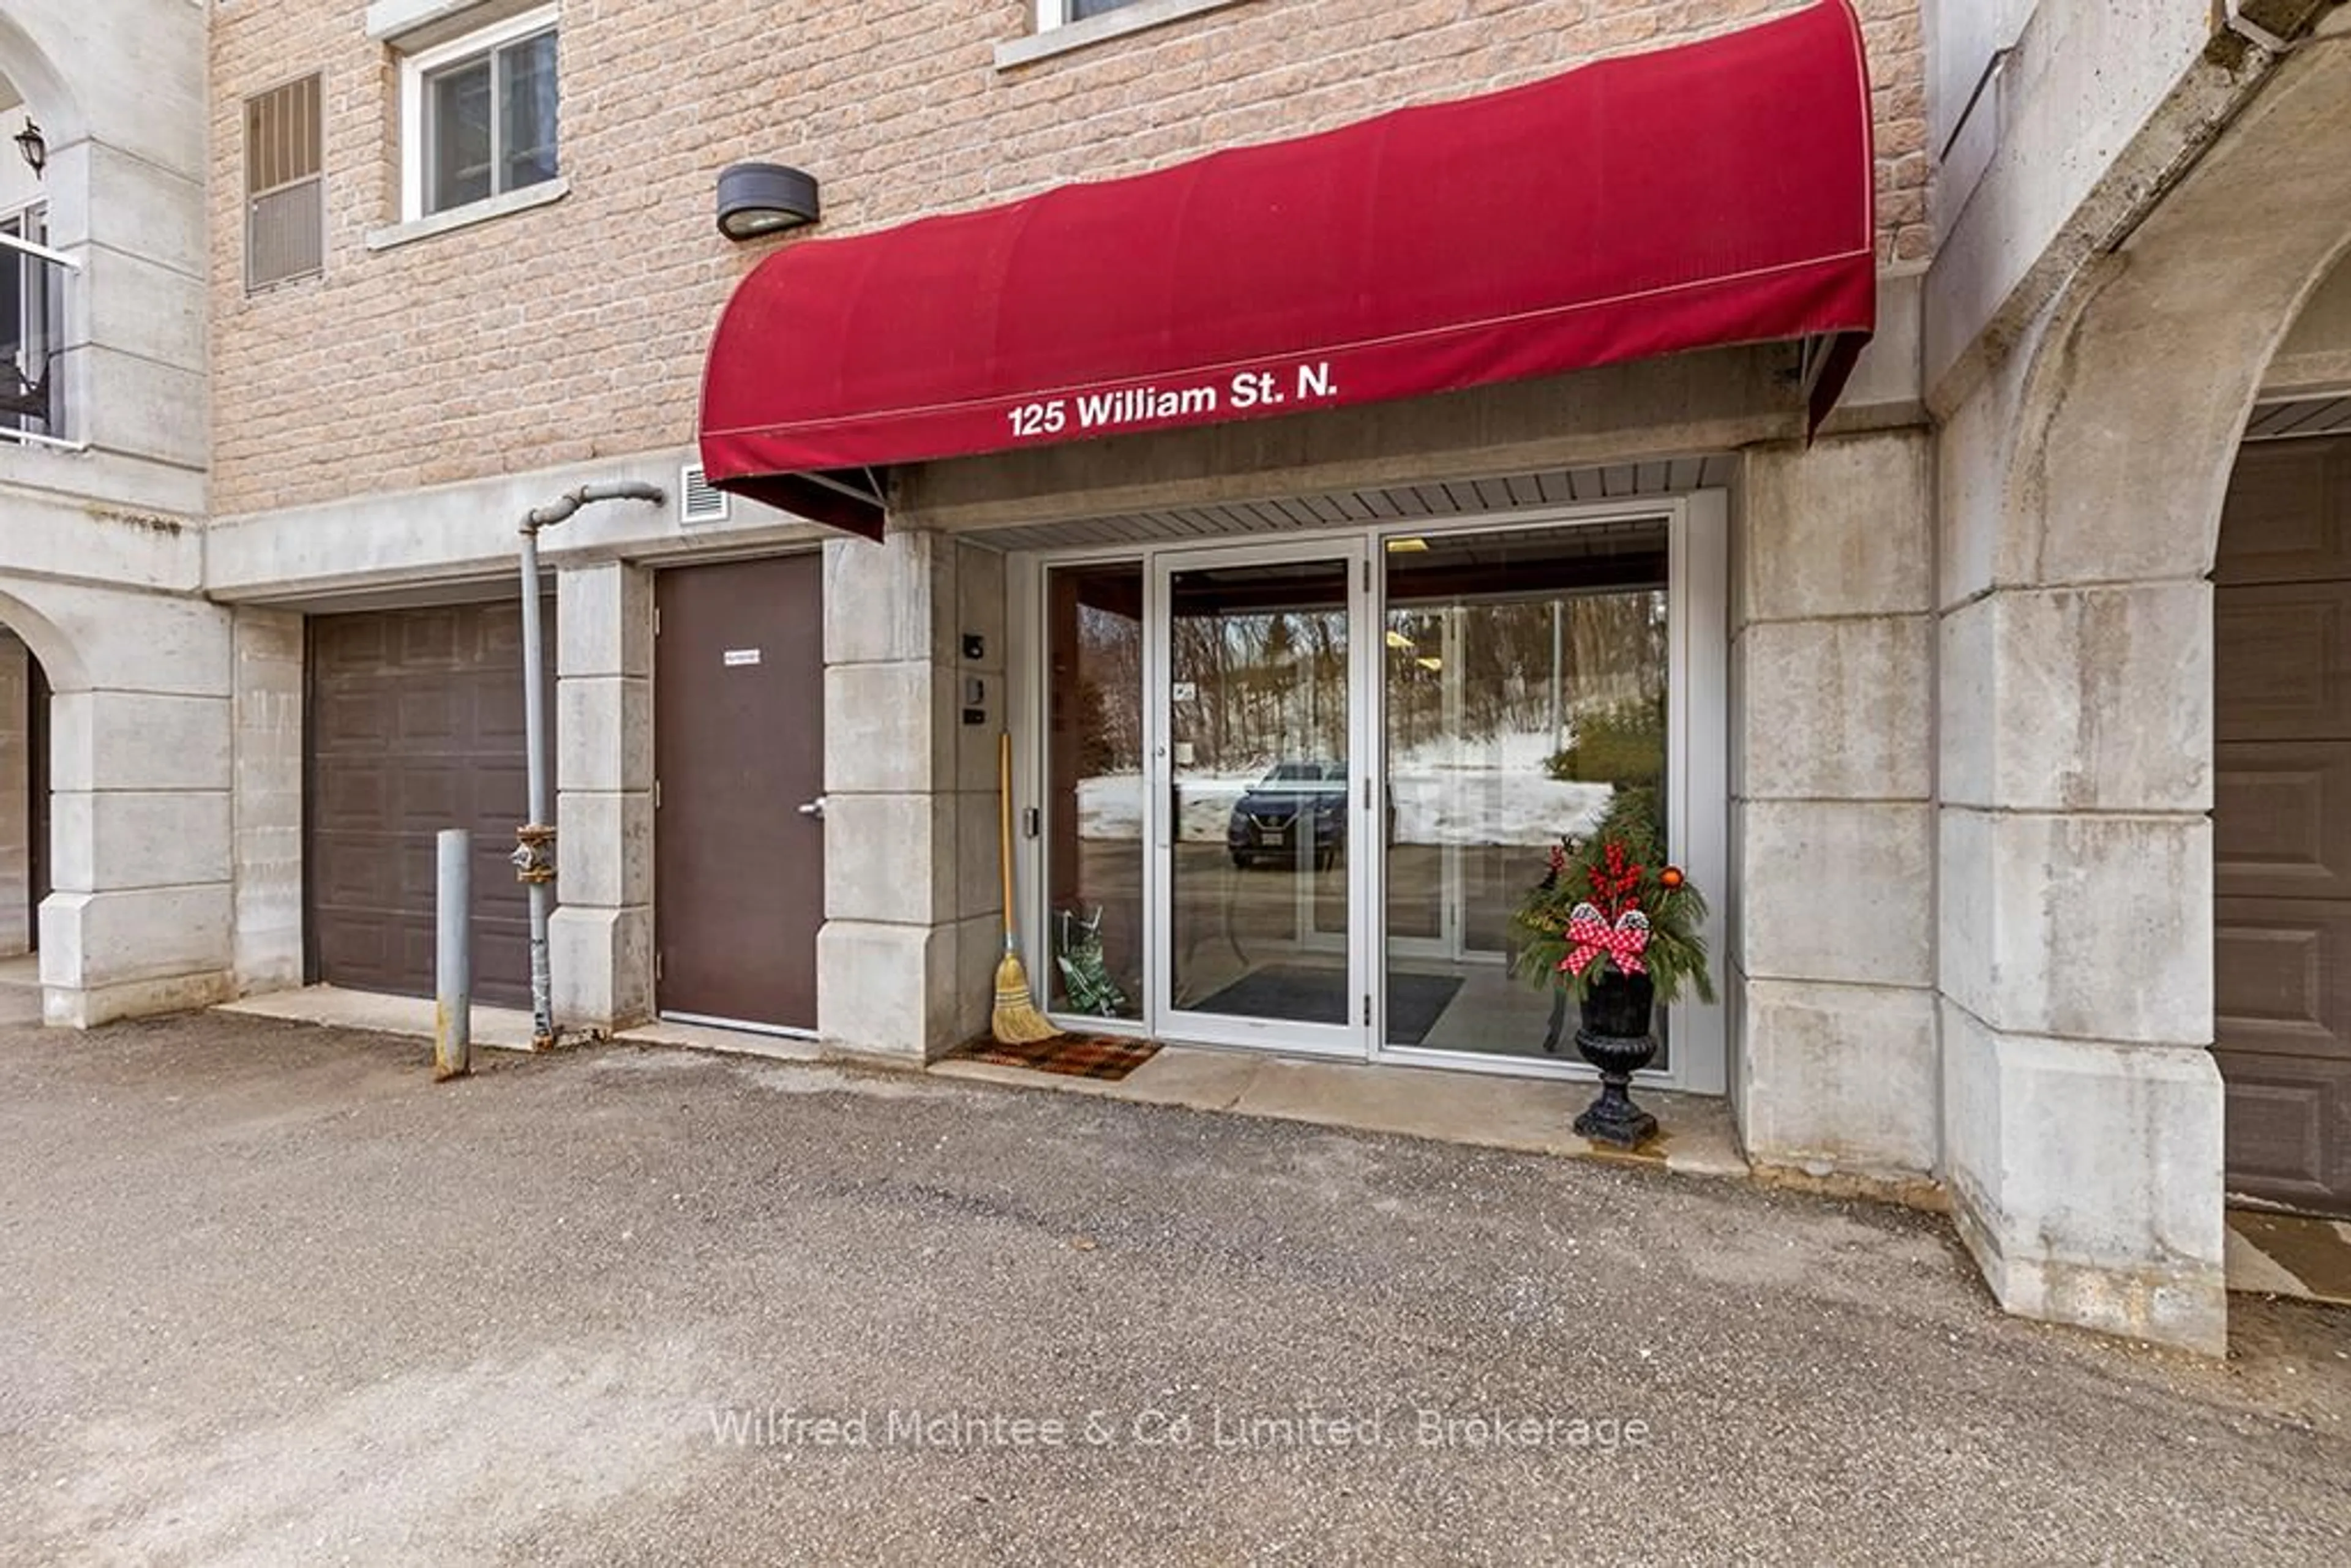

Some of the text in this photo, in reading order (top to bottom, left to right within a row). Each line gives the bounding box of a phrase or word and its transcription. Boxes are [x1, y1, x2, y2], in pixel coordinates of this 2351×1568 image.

[1008, 362, 1337, 437] 125 William St. N.
